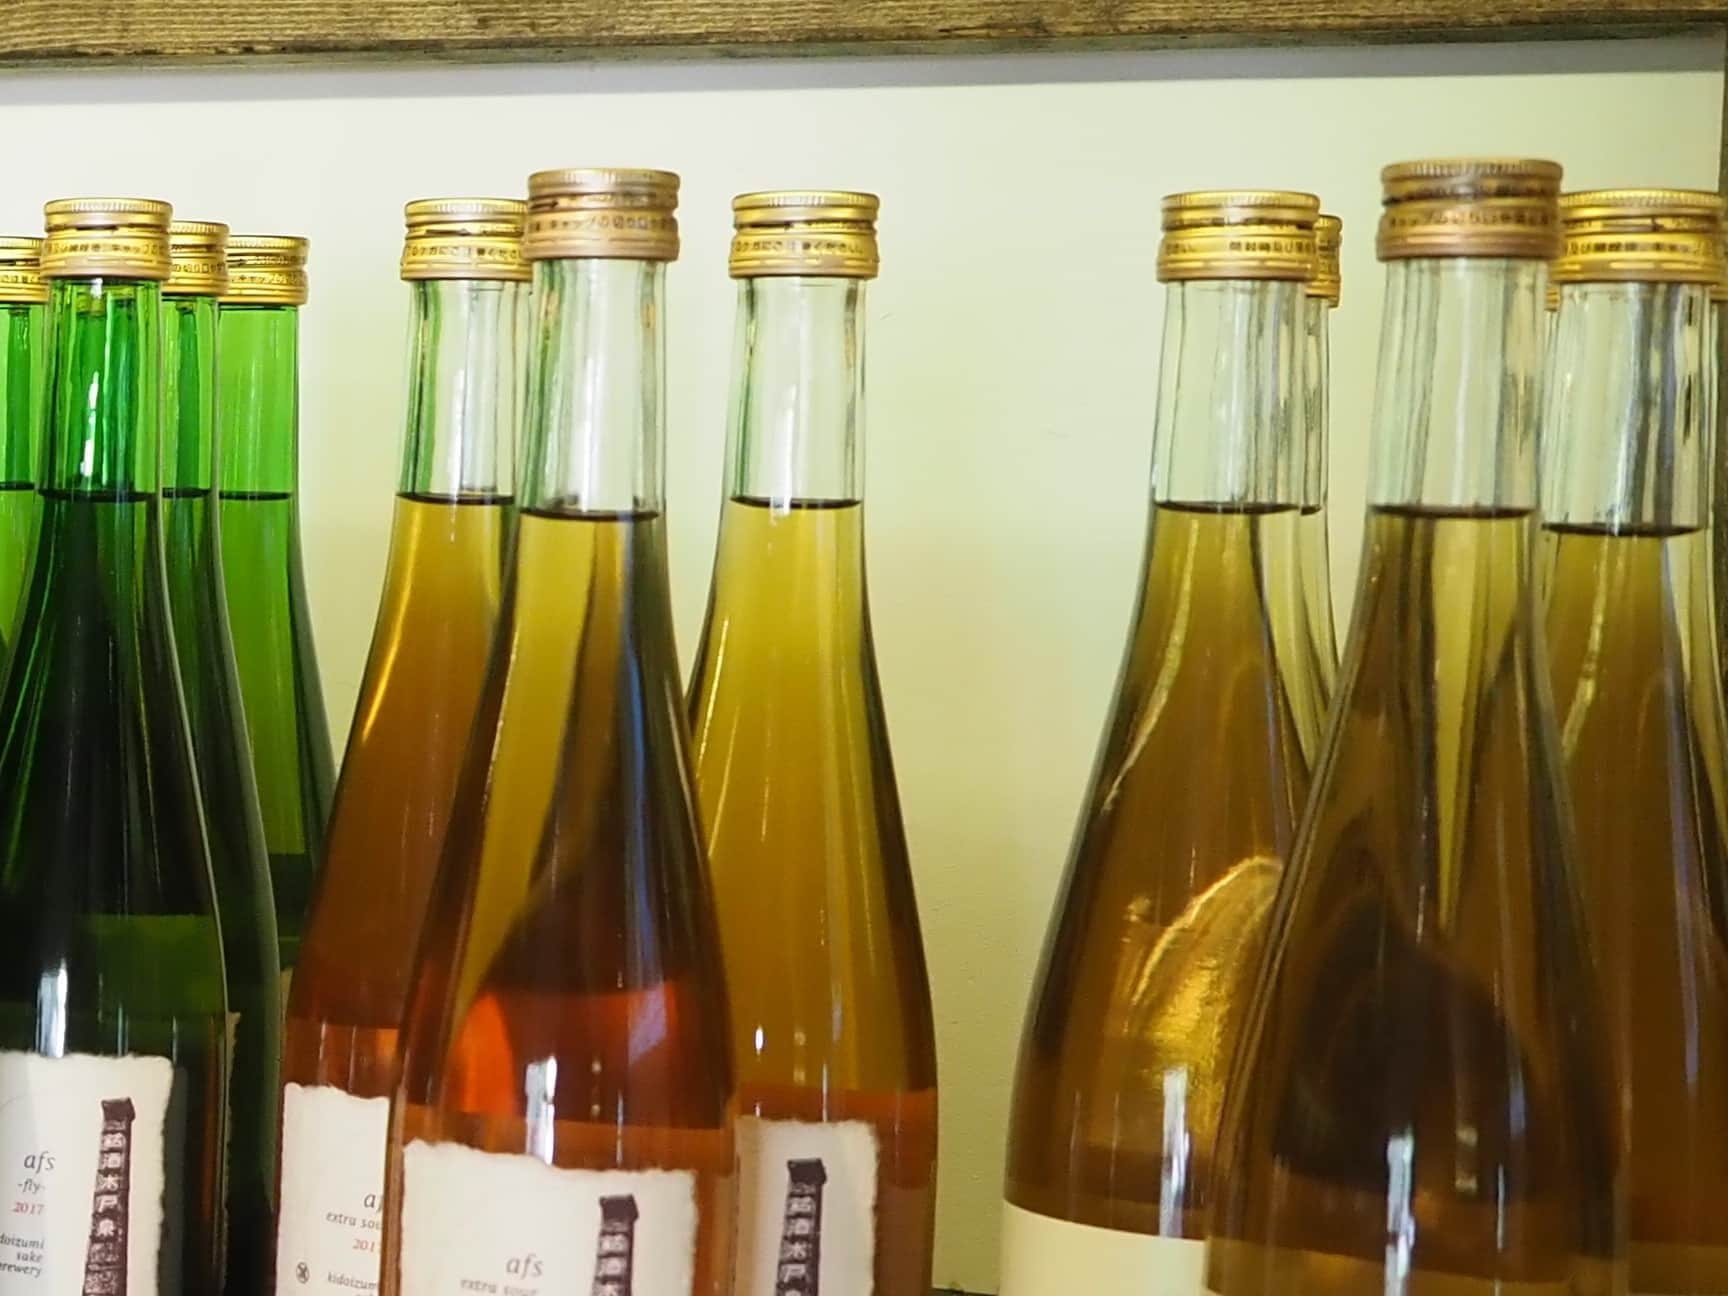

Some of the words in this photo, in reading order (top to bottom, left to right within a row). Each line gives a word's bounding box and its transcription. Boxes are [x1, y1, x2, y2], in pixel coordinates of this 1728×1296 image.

[23, 1150, 56, 1175] afs
[12, 1201, 45, 1217] 2017
[505, 1252, 544, 1279] afs
[459, 1277, 496, 1295] extra
